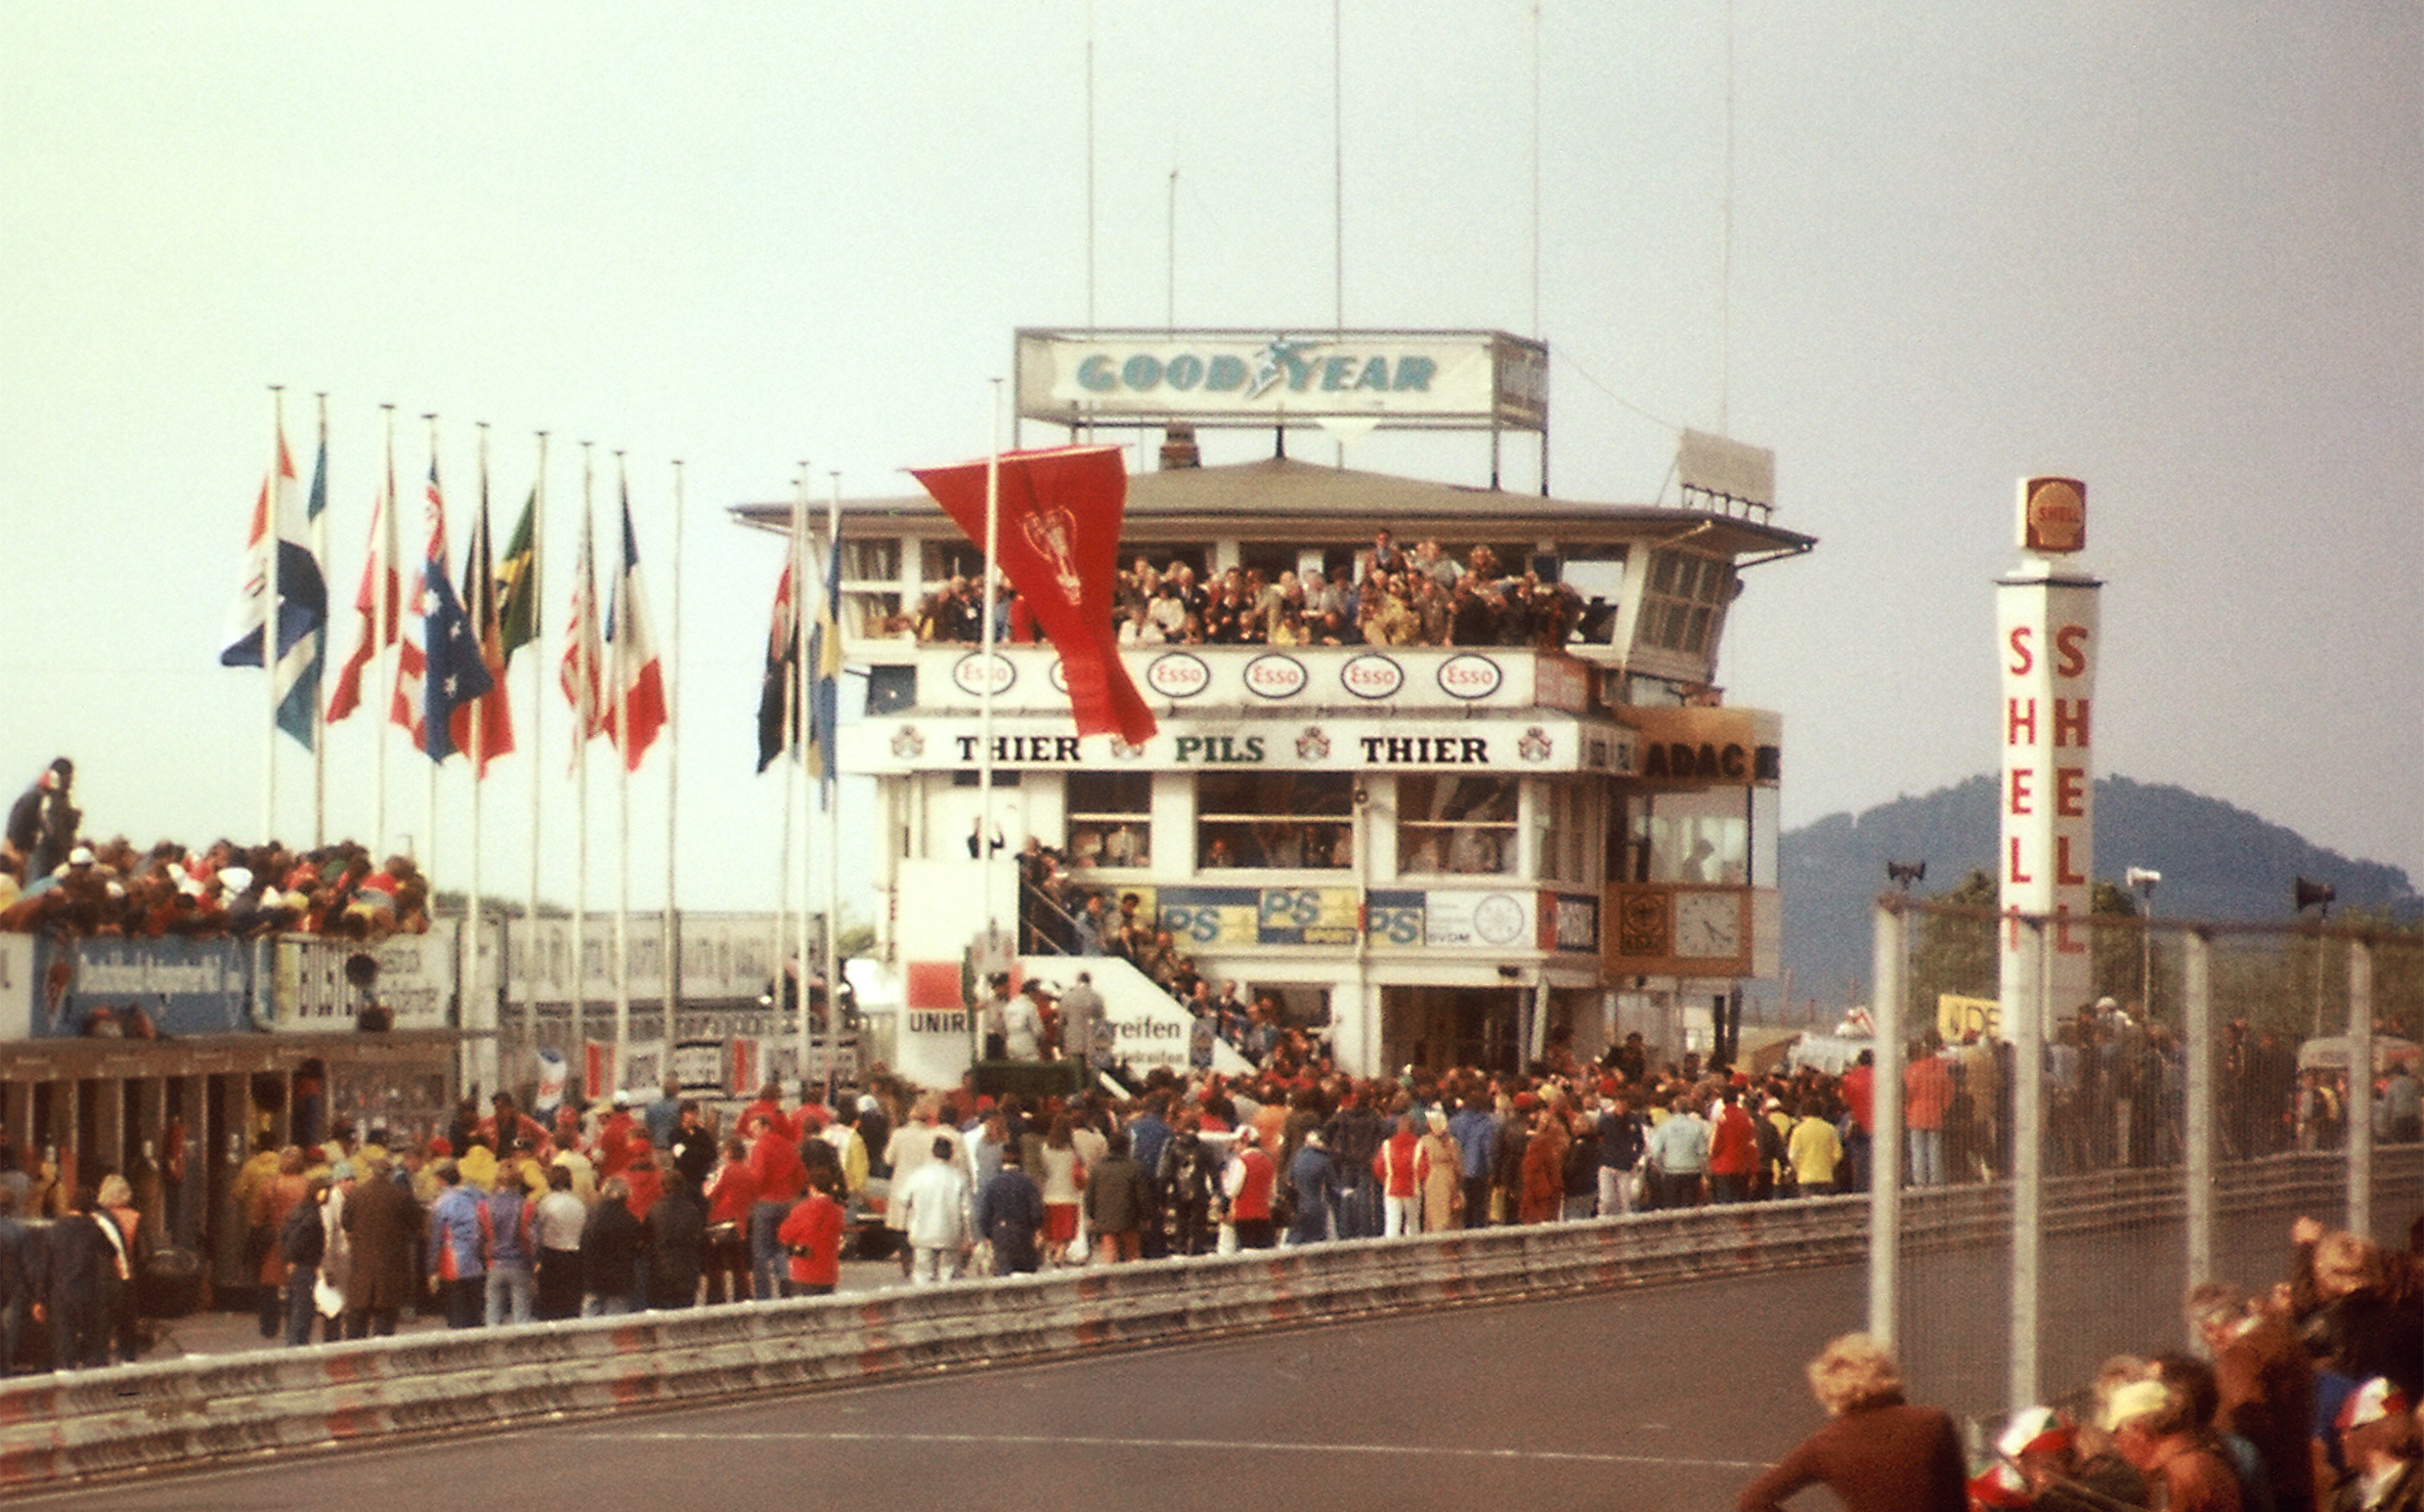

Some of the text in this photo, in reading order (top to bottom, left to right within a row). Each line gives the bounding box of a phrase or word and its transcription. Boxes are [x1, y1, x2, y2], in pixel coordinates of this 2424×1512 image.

[2038, 504, 2081, 523] SHELL
[963, 663, 1008, 682] Eso
[1157, 665, 1202, 683] Esso
[1254, 665, 1300, 684] Esso
[1351, 665, 1396, 684] Esso
[1448, 665, 1493, 684] Esso
[956, 736, 1490, 763] THIER PILS THIER
[2055, 625, 2090, 954] SHELL
[1264, 889, 1320, 925] PS
[1163, 907, 1220, 941] PS
[910, 1013, 967, 1033] UNIR
[1111, 1016, 1181, 1038] reifen
